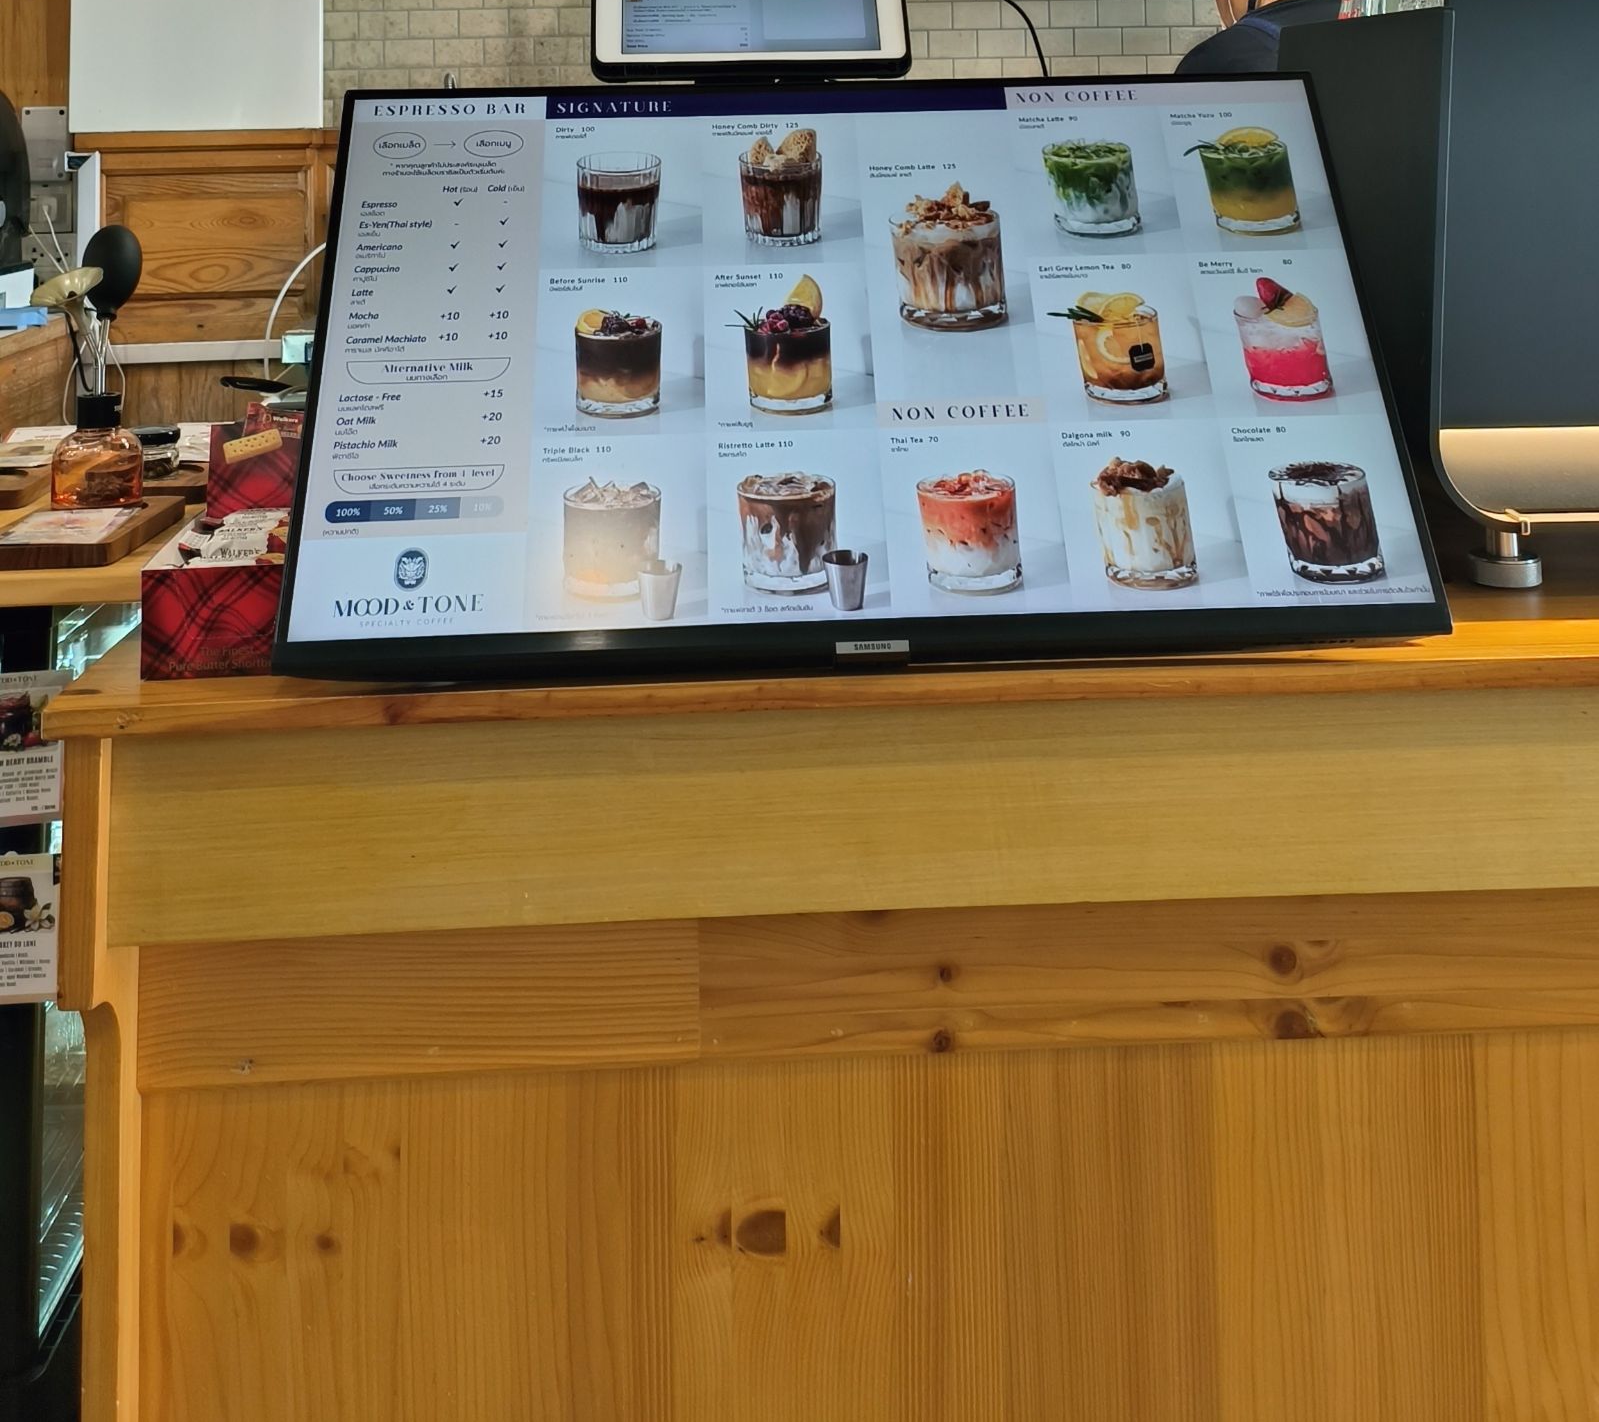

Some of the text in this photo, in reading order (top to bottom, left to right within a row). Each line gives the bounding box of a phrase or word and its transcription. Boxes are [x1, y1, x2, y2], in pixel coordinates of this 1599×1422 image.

[1016, 90, 1138, 103] NON COFFEE
[374, 102, 526, 116] ESPRESSO BAR
[556, 100, 672, 114] SIGNATURE
[1046, 115, 1064, 123] Latte
[555, 125, 596, 134] Dirty 100
[712, 121, 799, 131] Honey Comb Dirty 125
[869, 164, 892, 172] Honey
[894, 163, 915, 171] Comb
[442, 185, 458, 194] Hot
[487, 183, 506, 193] Cold
[361, 200, 397, 210] Espresso
[356, 242, 403, 252] Americano
[354, 264, 400, 275] Cappucino
[1055, 265, 1073, 273] Grey
[549, 277, 575, 285] Before
[578, 276, 605, 284] Sunrise
[715, 273, 733, 281] After
[351, 288, 374, 297] Latte
[349, 310, 509, 321] Mocha +10 +10
[346, 331, 508, 344] Caramel Machiato +10 +10
[384, 362, 473, 374] Alternative Milk
[339, 388, 503, 402] Lactose Free +15
[891, 403, 1030, 421] NON COFFEE
[336, 412, 502, 426] Oat Milk +20
[1231, 426, 1271, 434] Chocolate
[910, 436, 923, 444] Tea
[1061, 432, 1094, 441] Dalgona
[1096, 431, 1112, 439] milk
[333, 435, 501, 450] Pistachio Milk +20
[718, 440, 793, 449] Ristretto Latte 110
[543, 445, 612, 455] Triple Black 110
[335, 507, 361, 517] 100%
[383, 505, 403, 516] 50%
[427, 504, 448, 514] 25%
[360, 617, 454, 628] SPECIALTY COFFEE
[854, 643, 892, 651] SAMSUNG
[169, 659, 229, 672] Pure Butter
